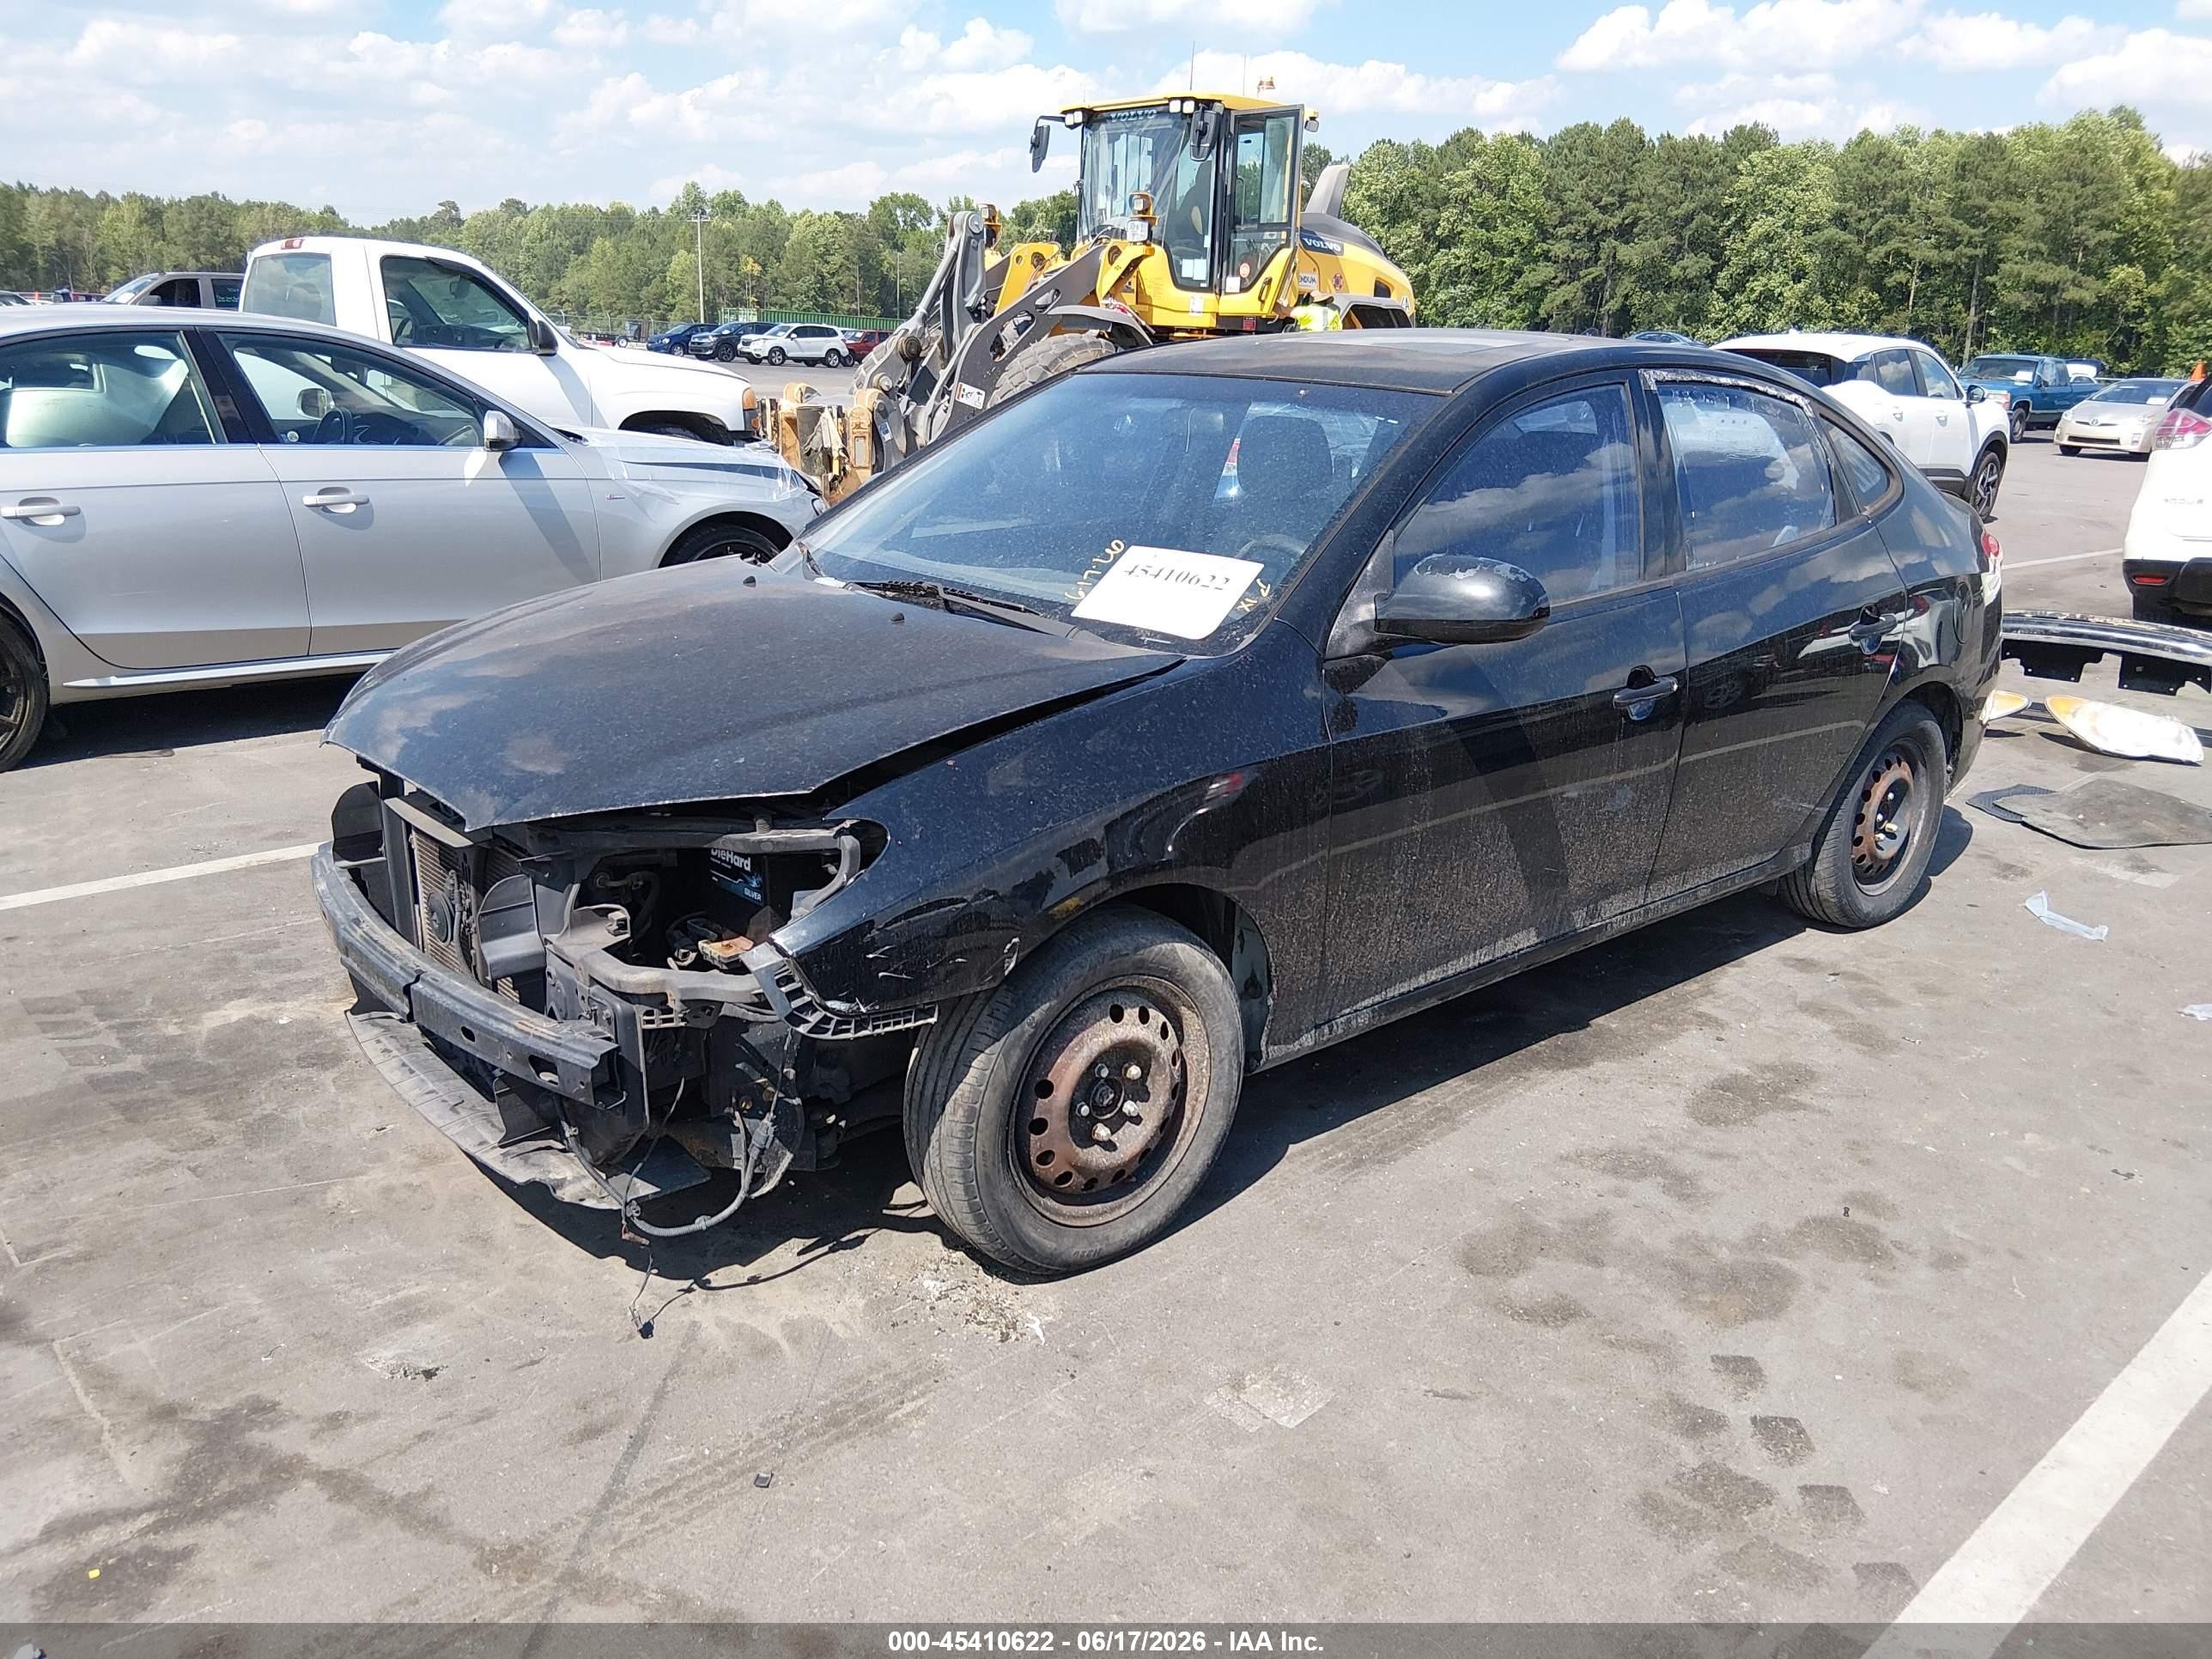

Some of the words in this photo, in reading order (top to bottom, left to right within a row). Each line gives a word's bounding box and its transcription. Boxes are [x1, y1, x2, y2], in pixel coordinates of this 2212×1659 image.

[1109, 109, 1158, 123] VOLVO
[1303, 238, 1341, 252] VOLVO
[1125, 564, 1231, 591] 45410622
